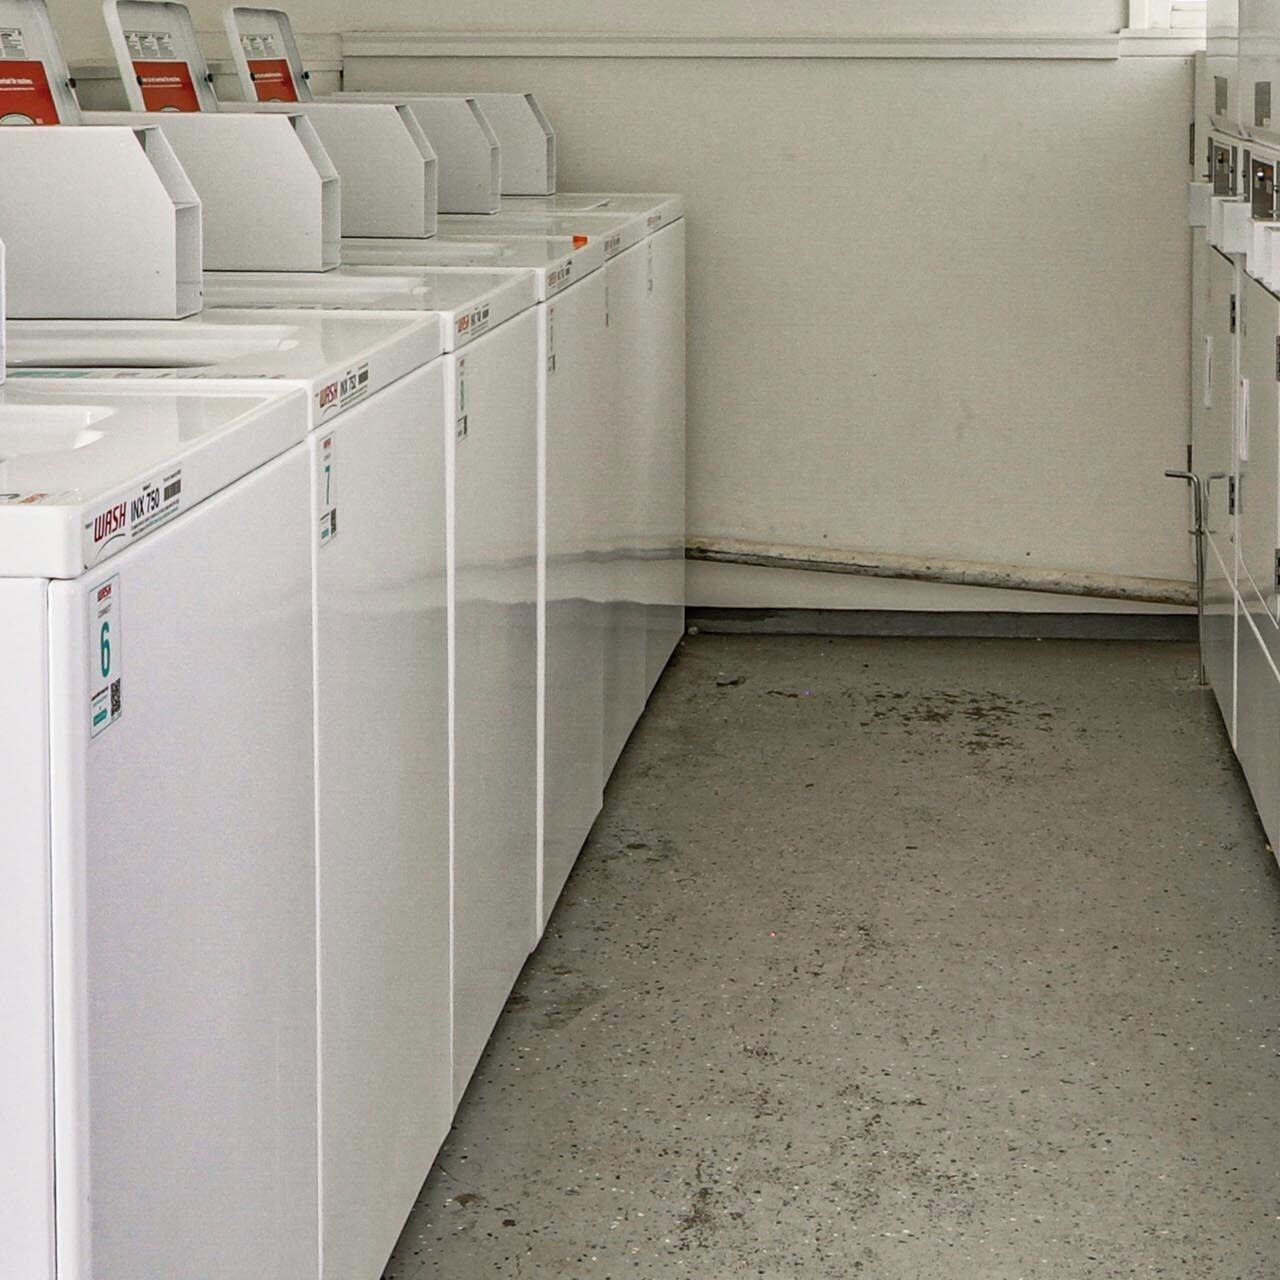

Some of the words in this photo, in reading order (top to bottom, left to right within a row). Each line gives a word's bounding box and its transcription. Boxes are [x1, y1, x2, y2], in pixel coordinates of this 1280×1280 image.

[320, 381, 337, 408] WASH
[94, 501, 127, 543] WASH
[130, 494, 145, 522] INX
[146, 487, 160, 513] 750
[101, 622, 110, 677] 6
